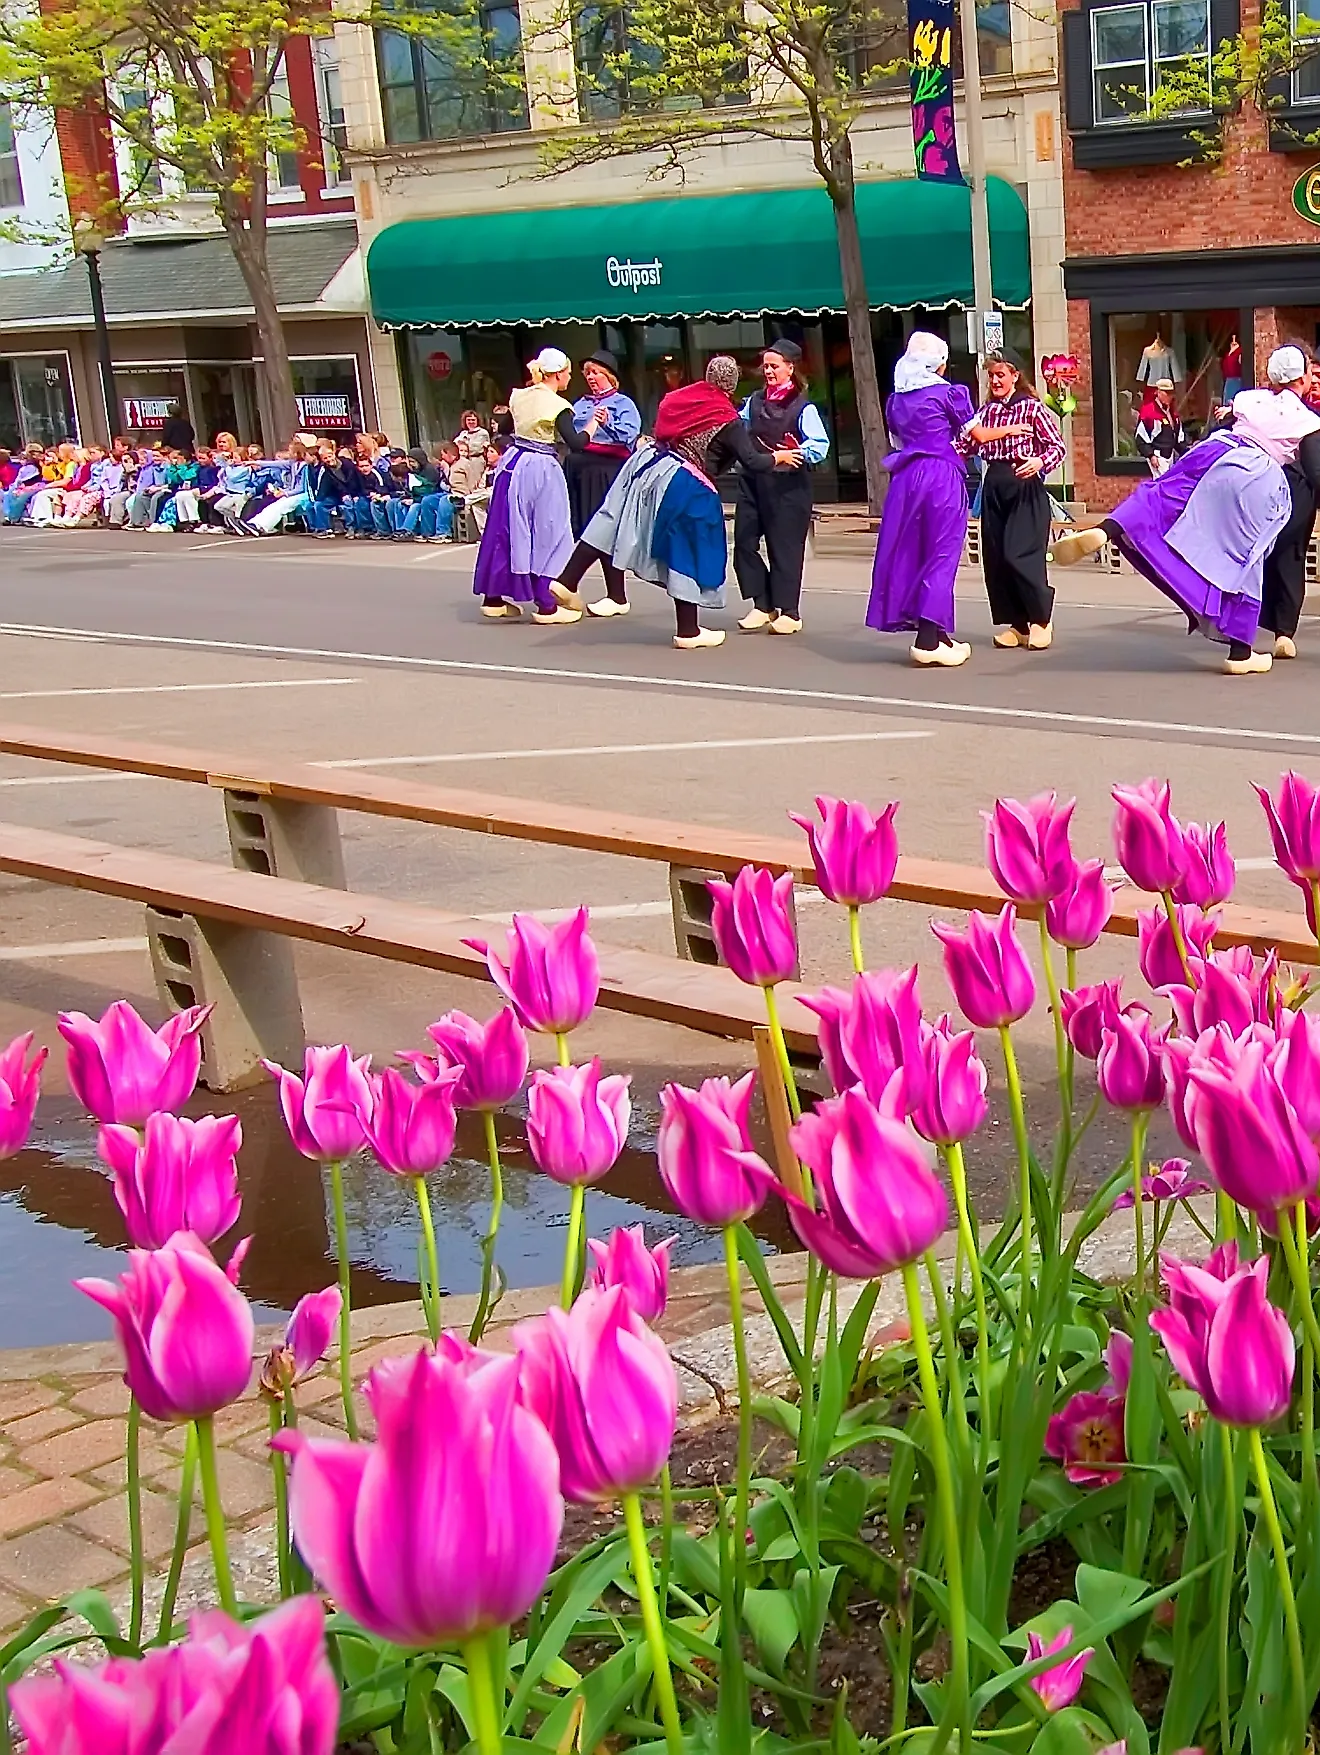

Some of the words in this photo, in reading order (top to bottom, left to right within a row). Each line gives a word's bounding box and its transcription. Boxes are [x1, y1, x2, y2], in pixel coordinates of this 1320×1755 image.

[607, 256, 663, 294] Outpost
[304, 398, 348, 417] FIREHOUSE
[310, 418, 347, 426] GUITARS
